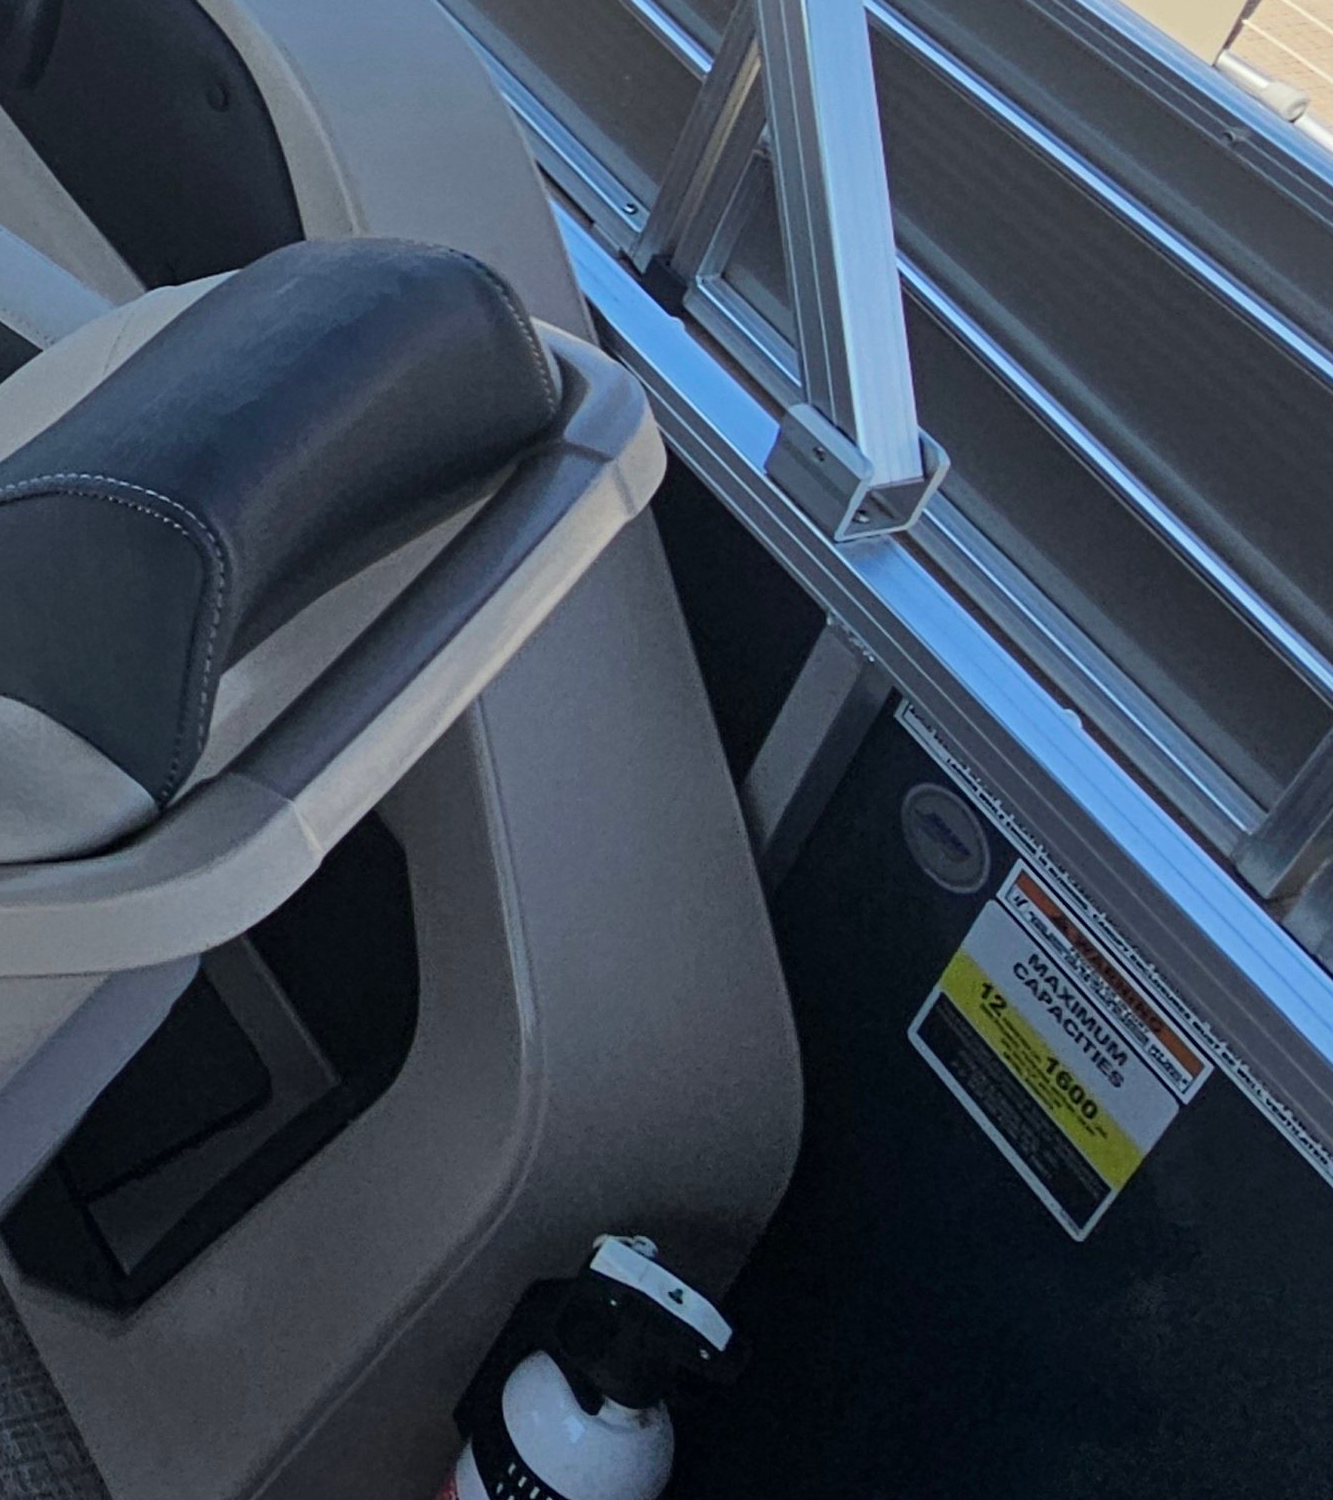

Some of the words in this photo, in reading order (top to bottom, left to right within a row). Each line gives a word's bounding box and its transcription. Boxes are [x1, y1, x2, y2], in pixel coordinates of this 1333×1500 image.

[1013, 962, 1125, 1088] CAPACITIES
[1028, 953, 1128, 1066] MAXIMUM
[1074, 937, 1163, 1033] WARNING
[980, 981, 1008, 1017] 12
[1044, 1056, 1098, 1120] 1600
